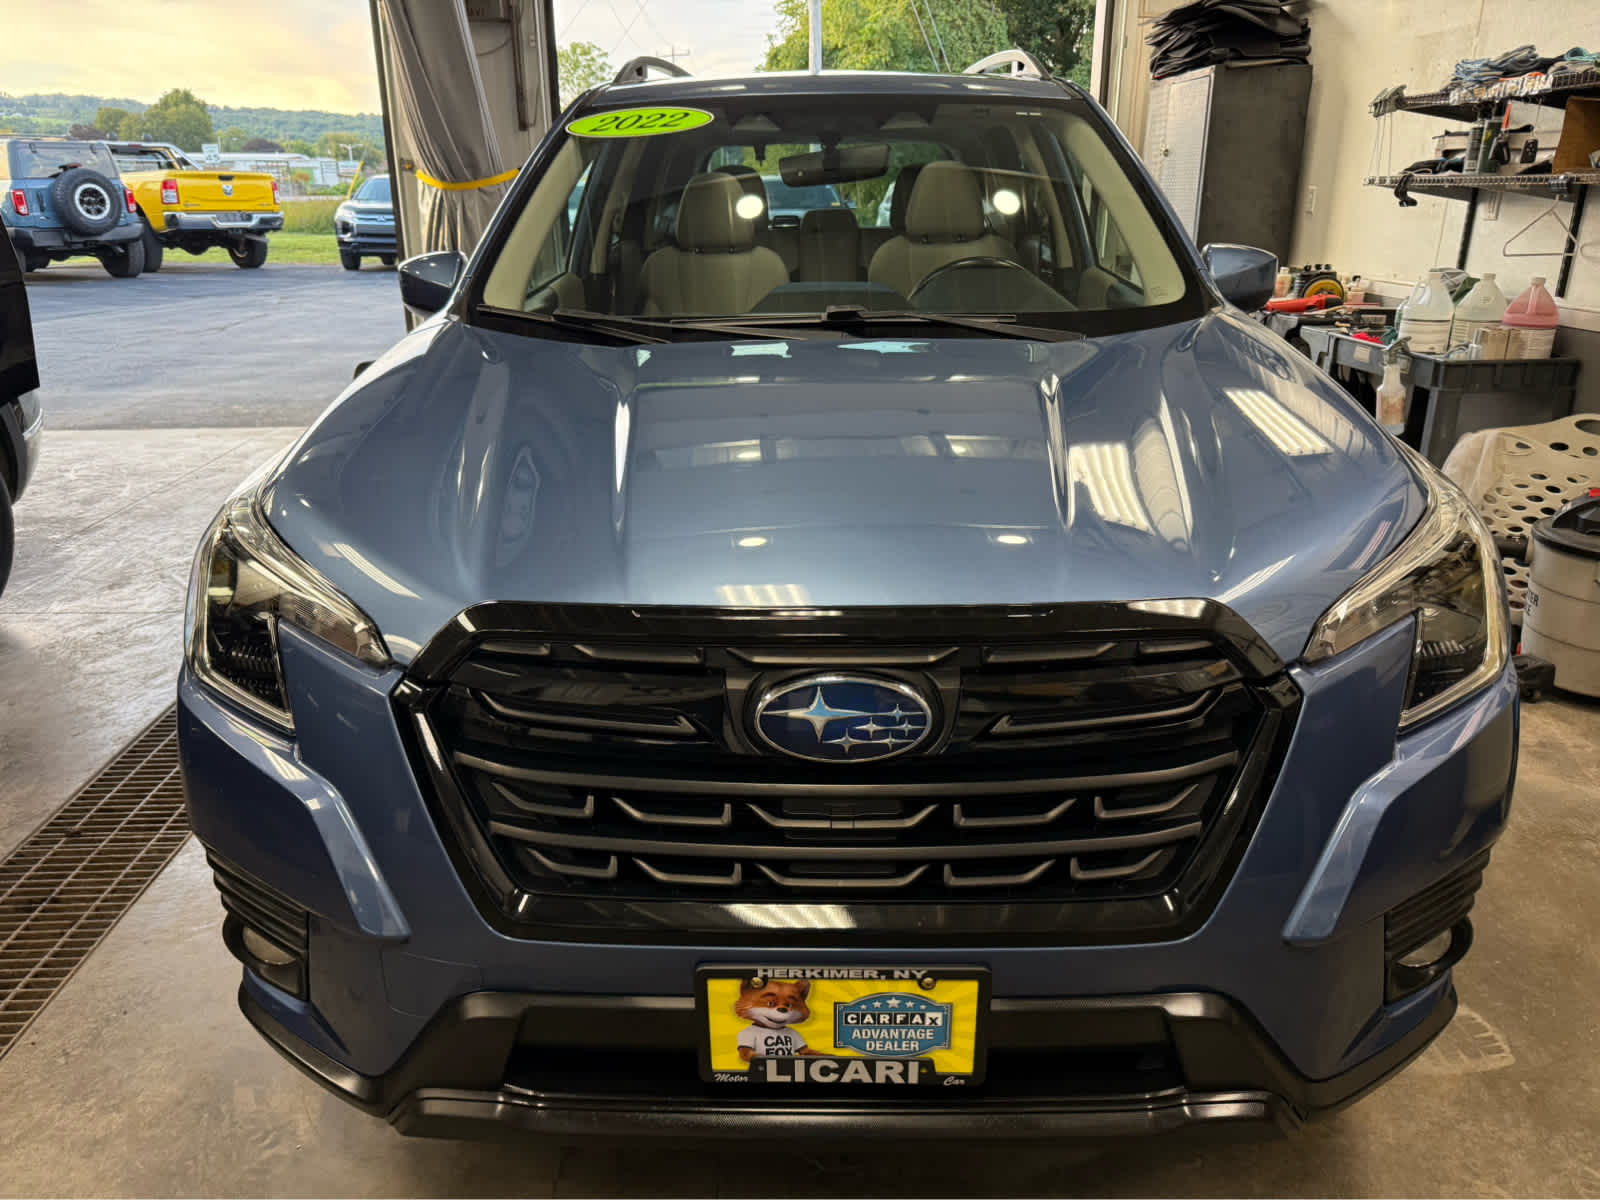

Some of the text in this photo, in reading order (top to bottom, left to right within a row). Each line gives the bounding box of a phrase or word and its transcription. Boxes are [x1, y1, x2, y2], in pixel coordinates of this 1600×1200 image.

[589, 112, 689, 132] 2022
[757, 968, 928, 980] HERKIMER, NY
[843, 1012, 942, 1026] CARFAX
[851, 1029, 935, 1040] ADVANTAGE
[764, 1035, 793, 1047] CAR
[865, 1040, 920, 1052] DEALER
[765, 1047, 796, 1056] FOX
[766, 1060, 920, 1084] LICARI
[714, 1073, 966, 1087] Motor Car
